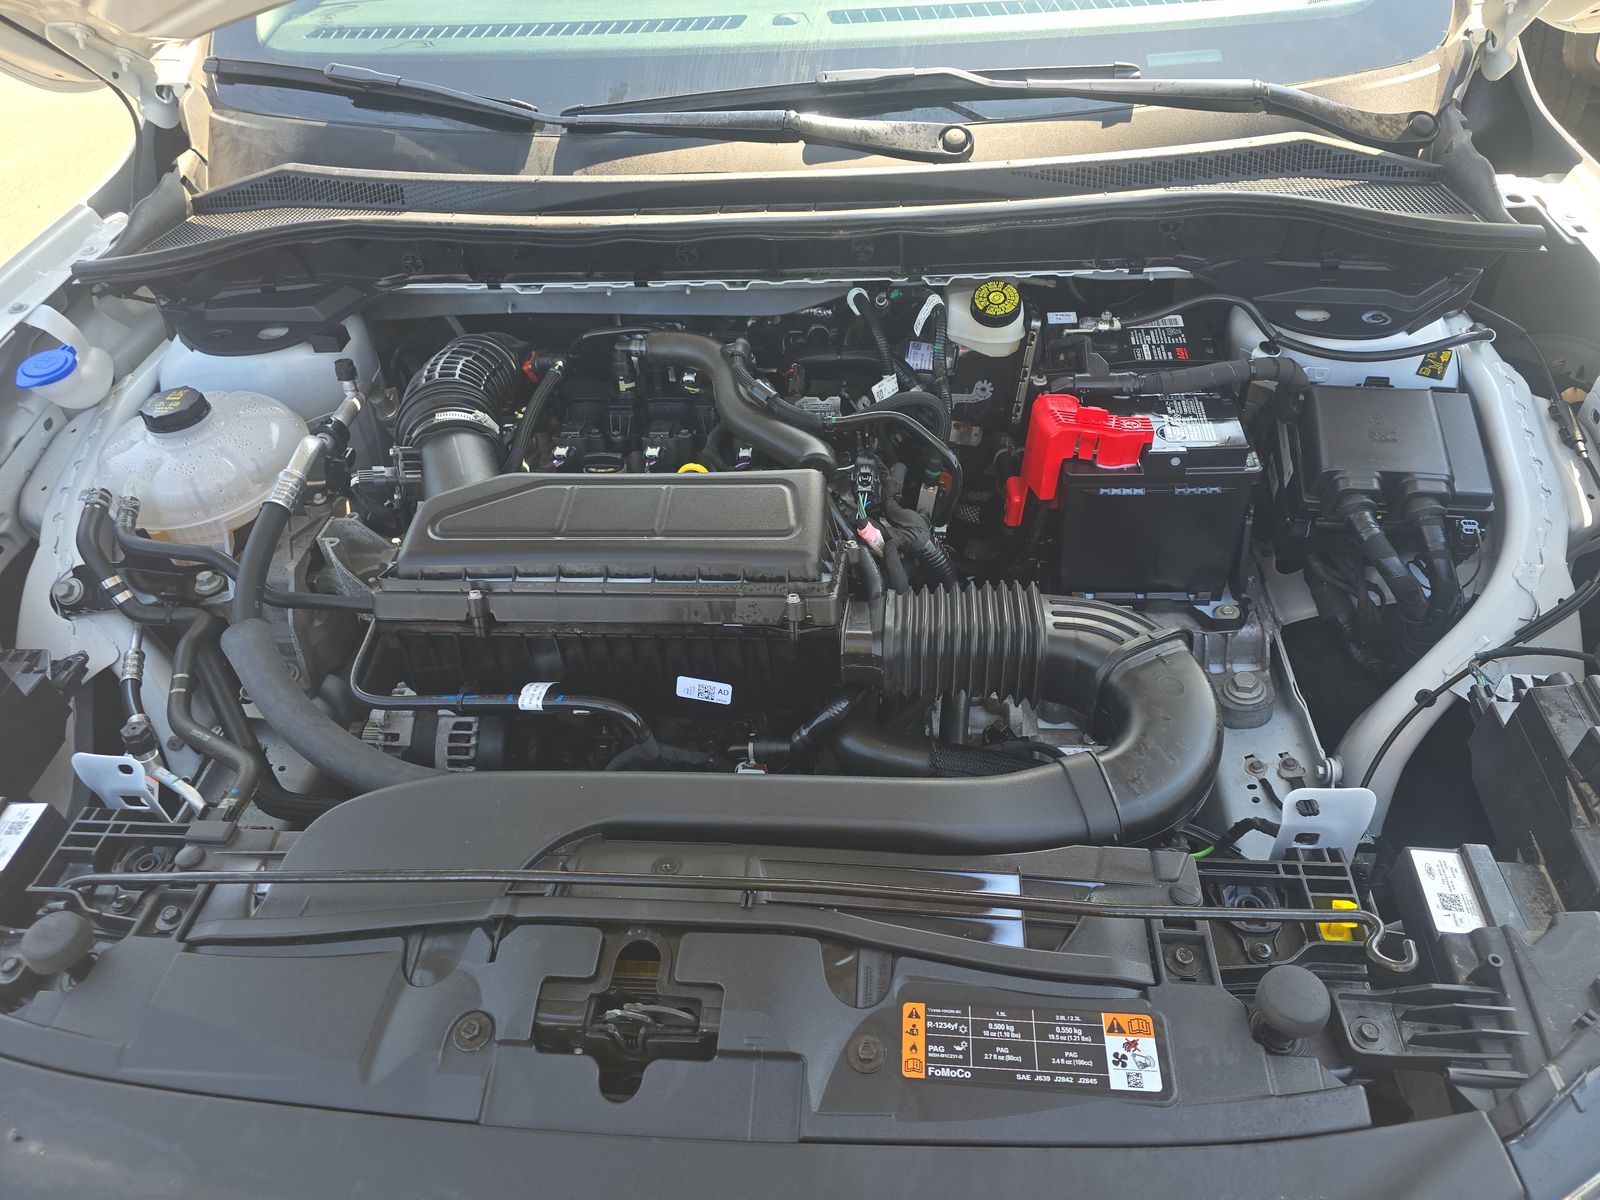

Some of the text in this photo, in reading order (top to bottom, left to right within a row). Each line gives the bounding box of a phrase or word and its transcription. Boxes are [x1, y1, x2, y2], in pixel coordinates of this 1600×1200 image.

[717, 688, 730, 696] AD
[927, 1021, 959, 1031] R-1234yf
[988, 1022, 1015, 1032] 0.500 kg
[1055, 1026, 1083, 1036] 0.550 kg
[1010, 1032, 1021, 1040] lbs)
[1080, 1035, 1092, 1043] lbs)
[928, 1044, 945, 1053] PAG
[996, 1046, 1009, 1054] PAG
[1072, 1059, 1093, 1068] (100cc)
[928, 1066, 972, 1079] FoMoCo
[1016, 1073, 1098, 1085] SAE J639 J2842 J2845
